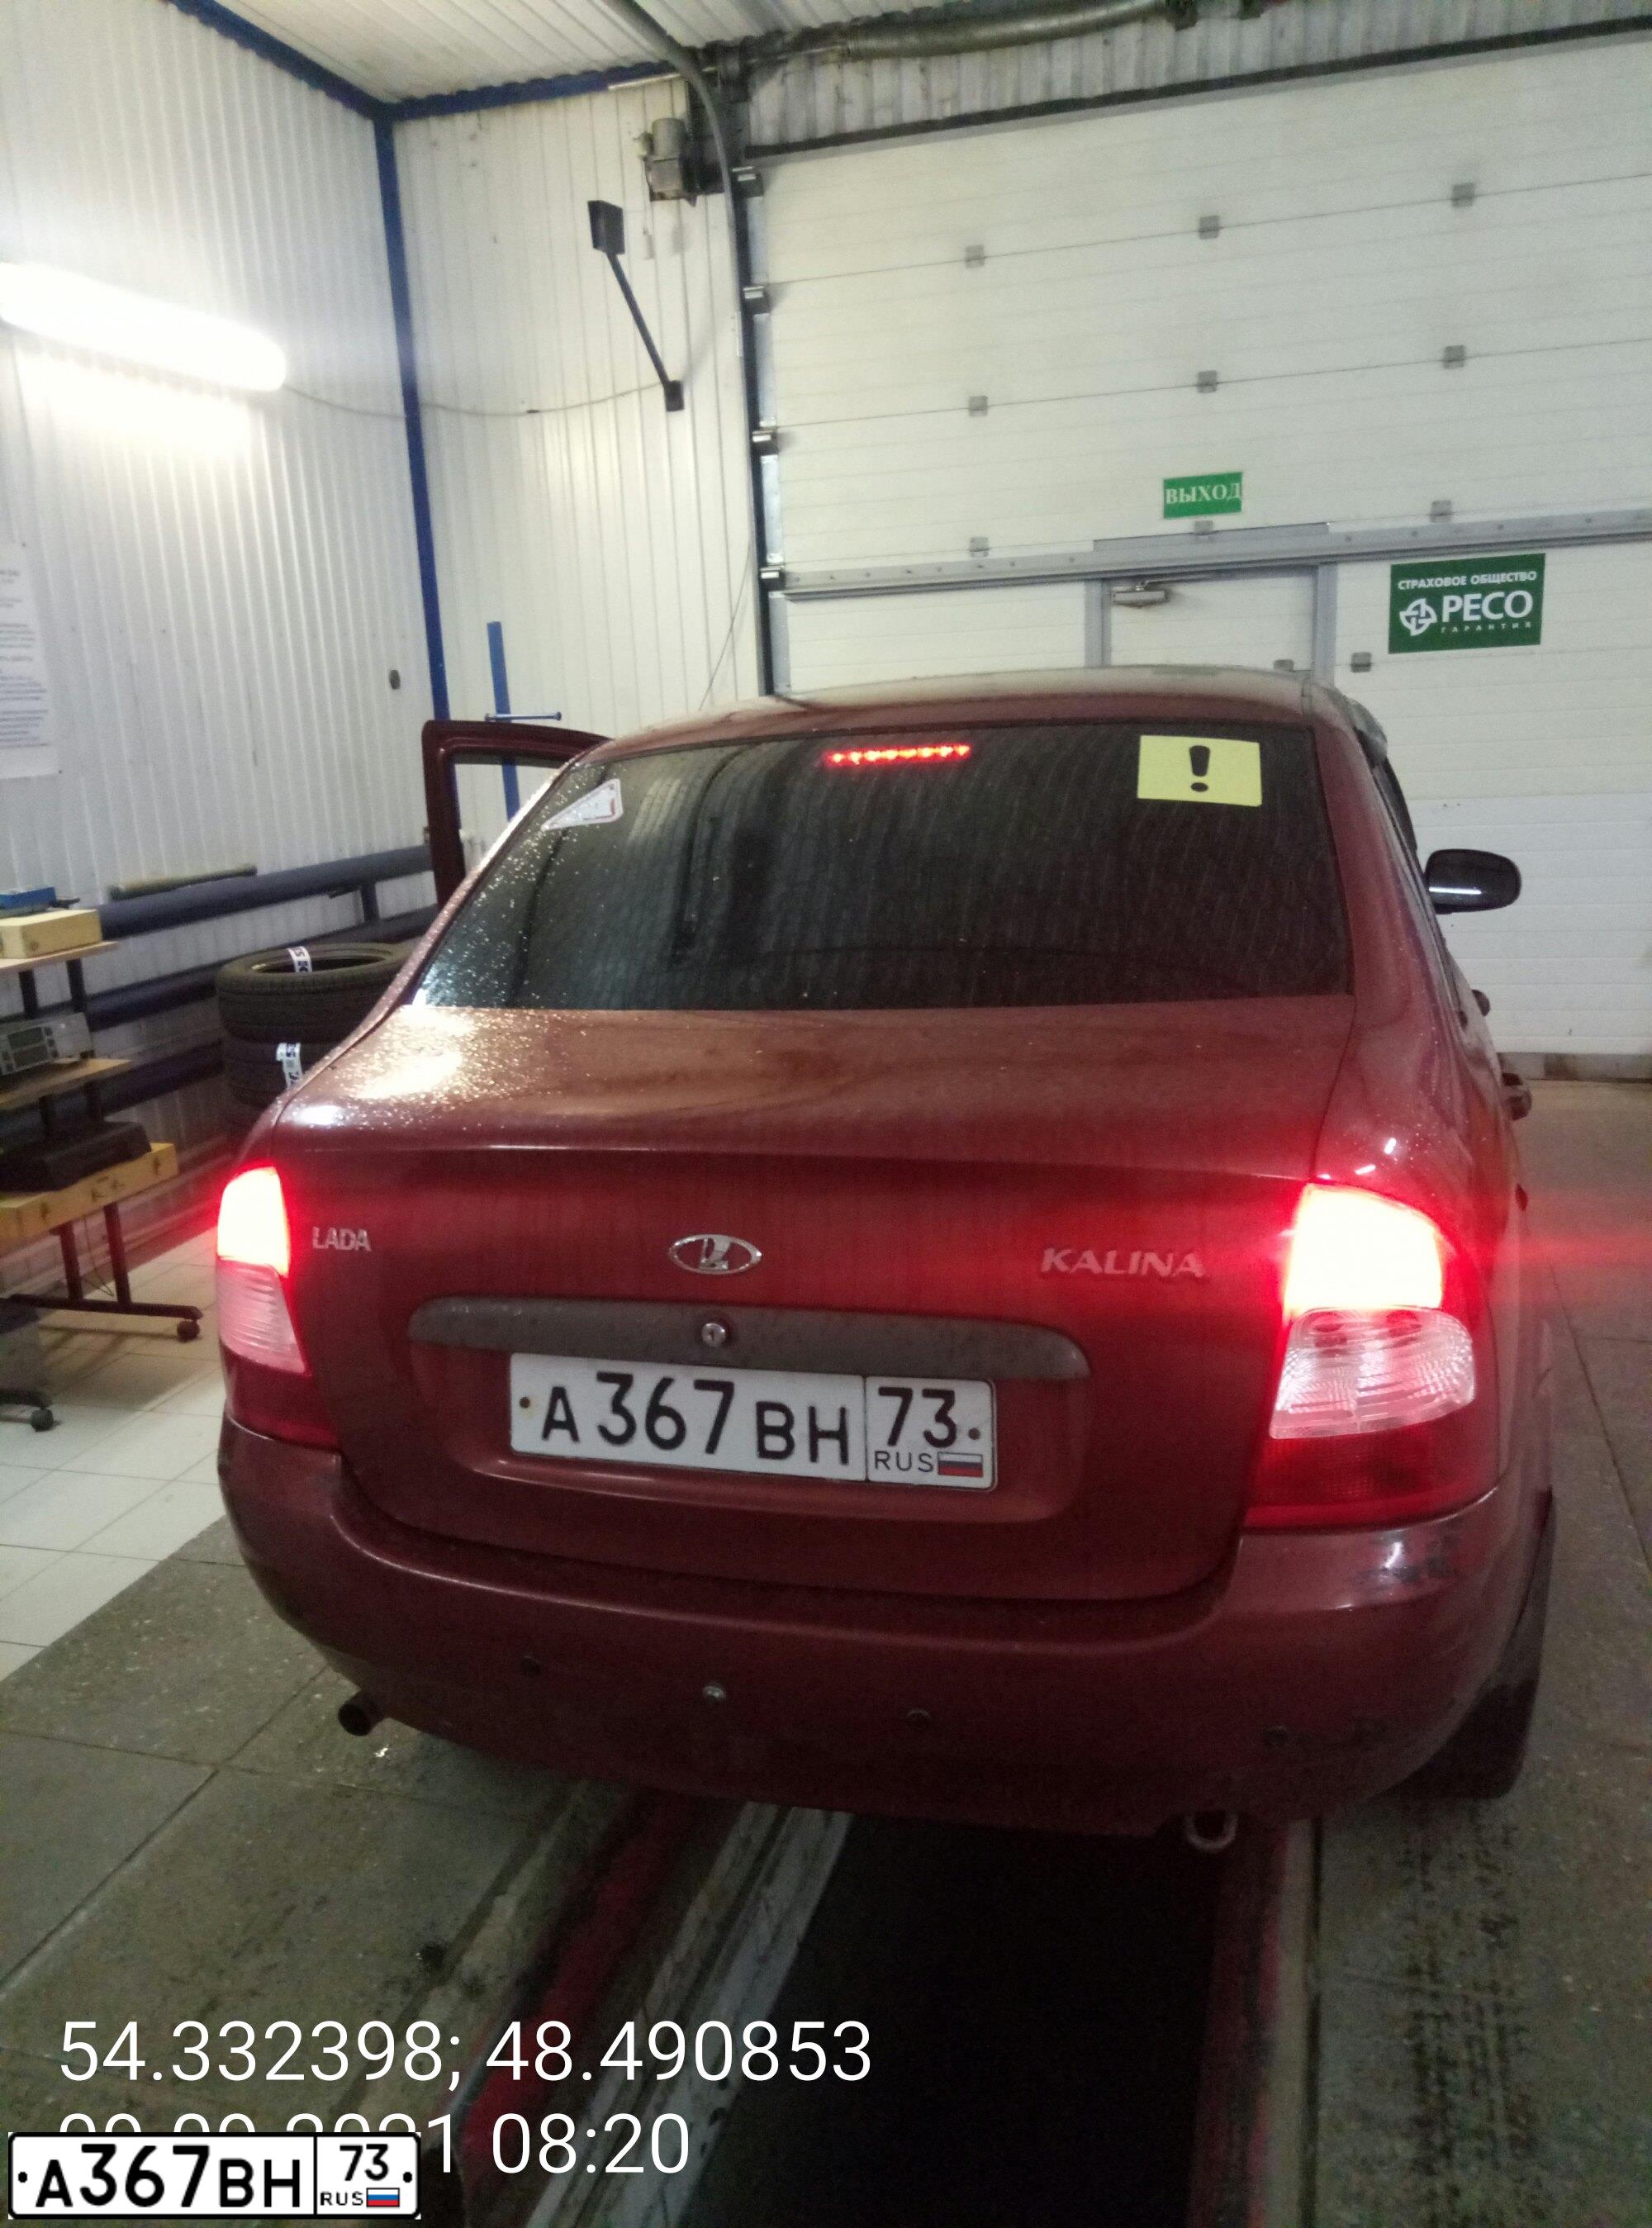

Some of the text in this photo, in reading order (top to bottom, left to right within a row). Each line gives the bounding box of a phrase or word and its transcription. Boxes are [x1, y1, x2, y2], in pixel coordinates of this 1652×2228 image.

[1164, 482, 1241, 505] ВЫХОД
[1398, 571, 1537, 590] СТРАХОВОЕ ОБЩЕСТВО
[1442, 590, 1534, 623] РЕСО
[312, 1226, 372, 1252] LADA
[1041, 1247, 1207, 1277] KALINA
[878, 1386, 957, 1448] 73
[874, 1451, 933, 1472] RUS
